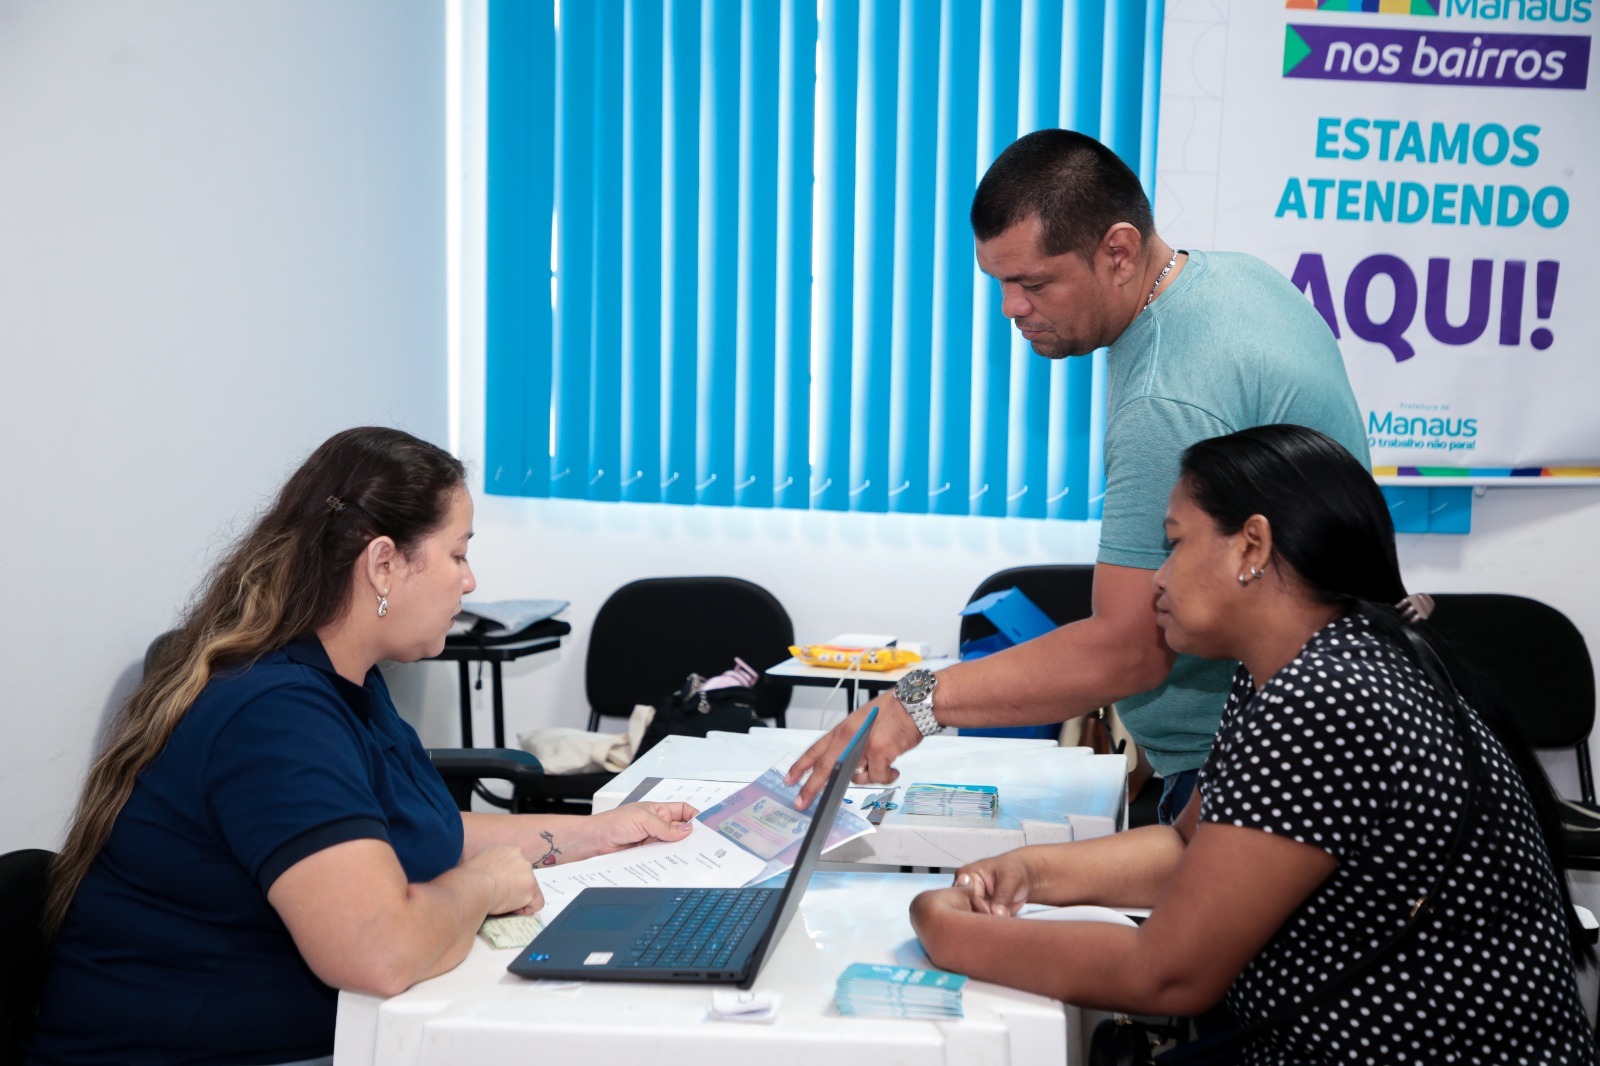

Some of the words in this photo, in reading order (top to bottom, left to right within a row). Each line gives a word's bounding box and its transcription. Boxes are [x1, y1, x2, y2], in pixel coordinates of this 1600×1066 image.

[1446, 0, 1592, 23] Manaus
[1324, 41, 1403, 75] nos
[1411, 36, 1567, 81] bairros
[1315, 116, 1541, 167] ESTAMOS
[1275, 177, 1570, 229] ATENDENDO
[1290, 253, 1560, 363] AQUI!
[1368, 410, 1478, 437] Manaus
[1368, 437, 1376, 447] O
[1378, 438, 1425, 448] trabalho
[1427, 439, 1447, 449] não
[1449, 440, 1476, 451] para!
